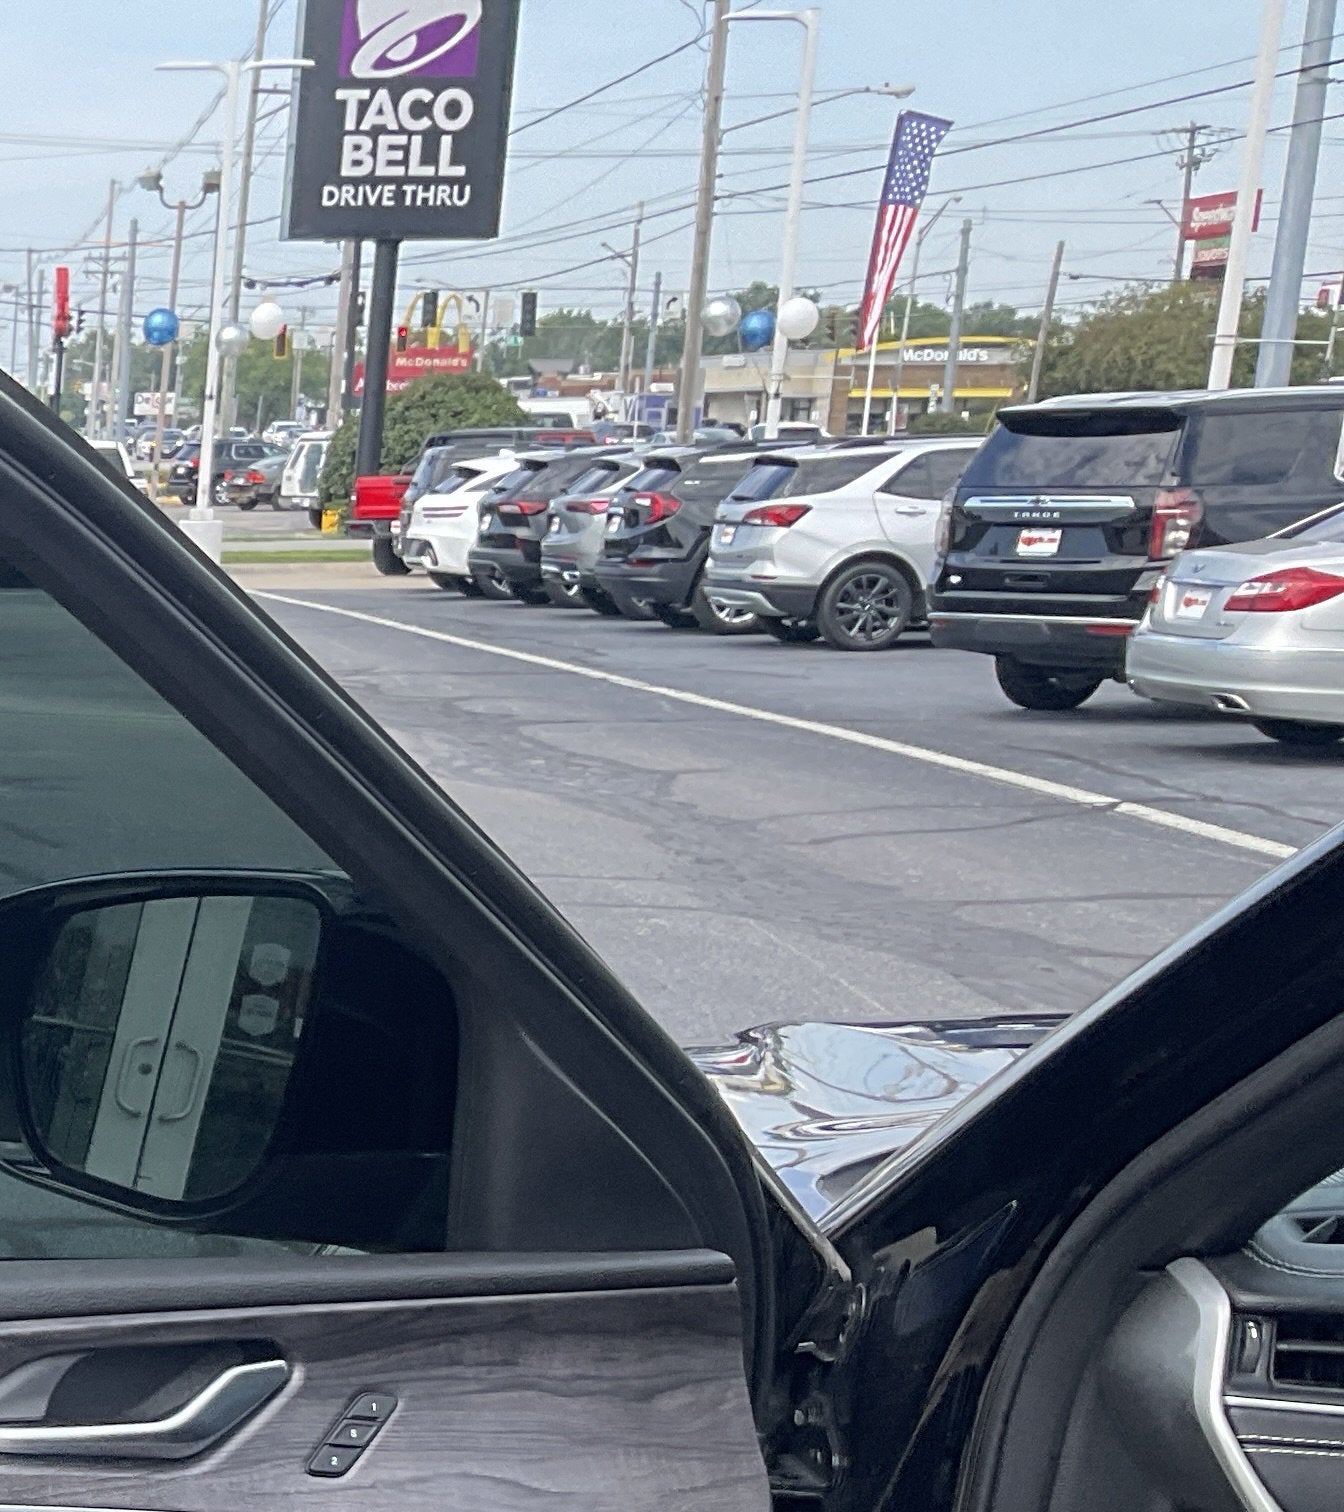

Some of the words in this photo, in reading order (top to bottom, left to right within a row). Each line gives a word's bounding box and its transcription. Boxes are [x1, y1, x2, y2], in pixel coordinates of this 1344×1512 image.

[335, 87, 474, 131] TACO
[340, 135, 466, 177] BELL
[321, 184, 395, 207] DRIVE
[402, 185, 471, 206] THRU
[395, 357, 468, 367] McDonald's
[370, 1402, 377, 1412] 1
[331, 1456, 338, 1466] 2
